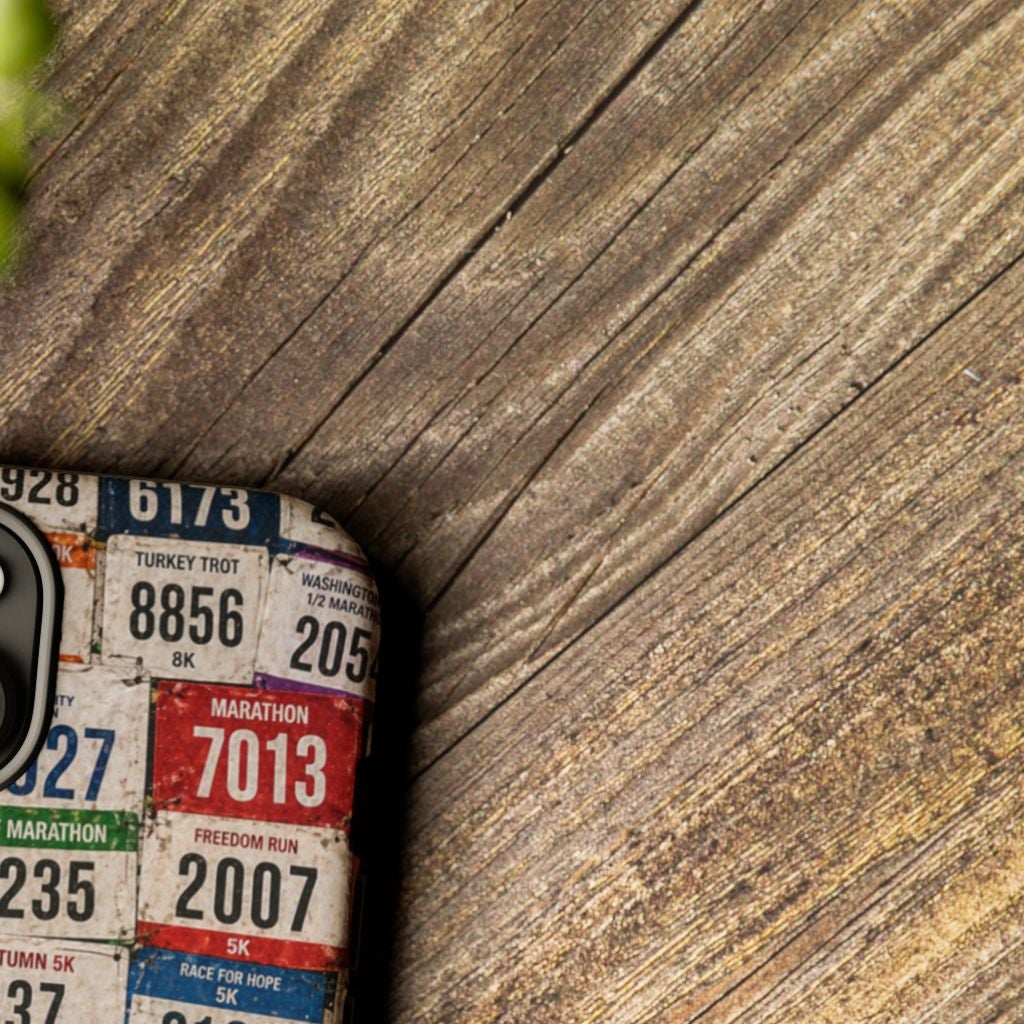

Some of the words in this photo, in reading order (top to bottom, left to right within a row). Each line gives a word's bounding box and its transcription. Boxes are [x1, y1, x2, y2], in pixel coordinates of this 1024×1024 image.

[129, 479, 251, 531] 6173
[135, 551, 196, 571] TURKEY
[200, 556, 240, 575] TROT
[129, 581, 244, 647] 8856
[307, 592, 326, 608] 1/2
[329, 597, 380, 623] MARATH
[171, 651, 196, 669] 8K
[211, 698, 309, 724] MARATHON
[193, 726, 327, 808] 7013
[7, 819, 108, 843] MARATHON
[194, 828, 263, 850] FREEDOM
[268, 837, 299, 854] RUN
[175, 852, 318, 932] 2007
[226, 938, 251, 956] 5K
[53, 955, 75, 973] 5K
[180, 962, 214, 981] RACE
[217, 969, 243, 985] FOR
[246, 973, 282, 992] HOPE
[215, 987, 239, 1005] 5K
